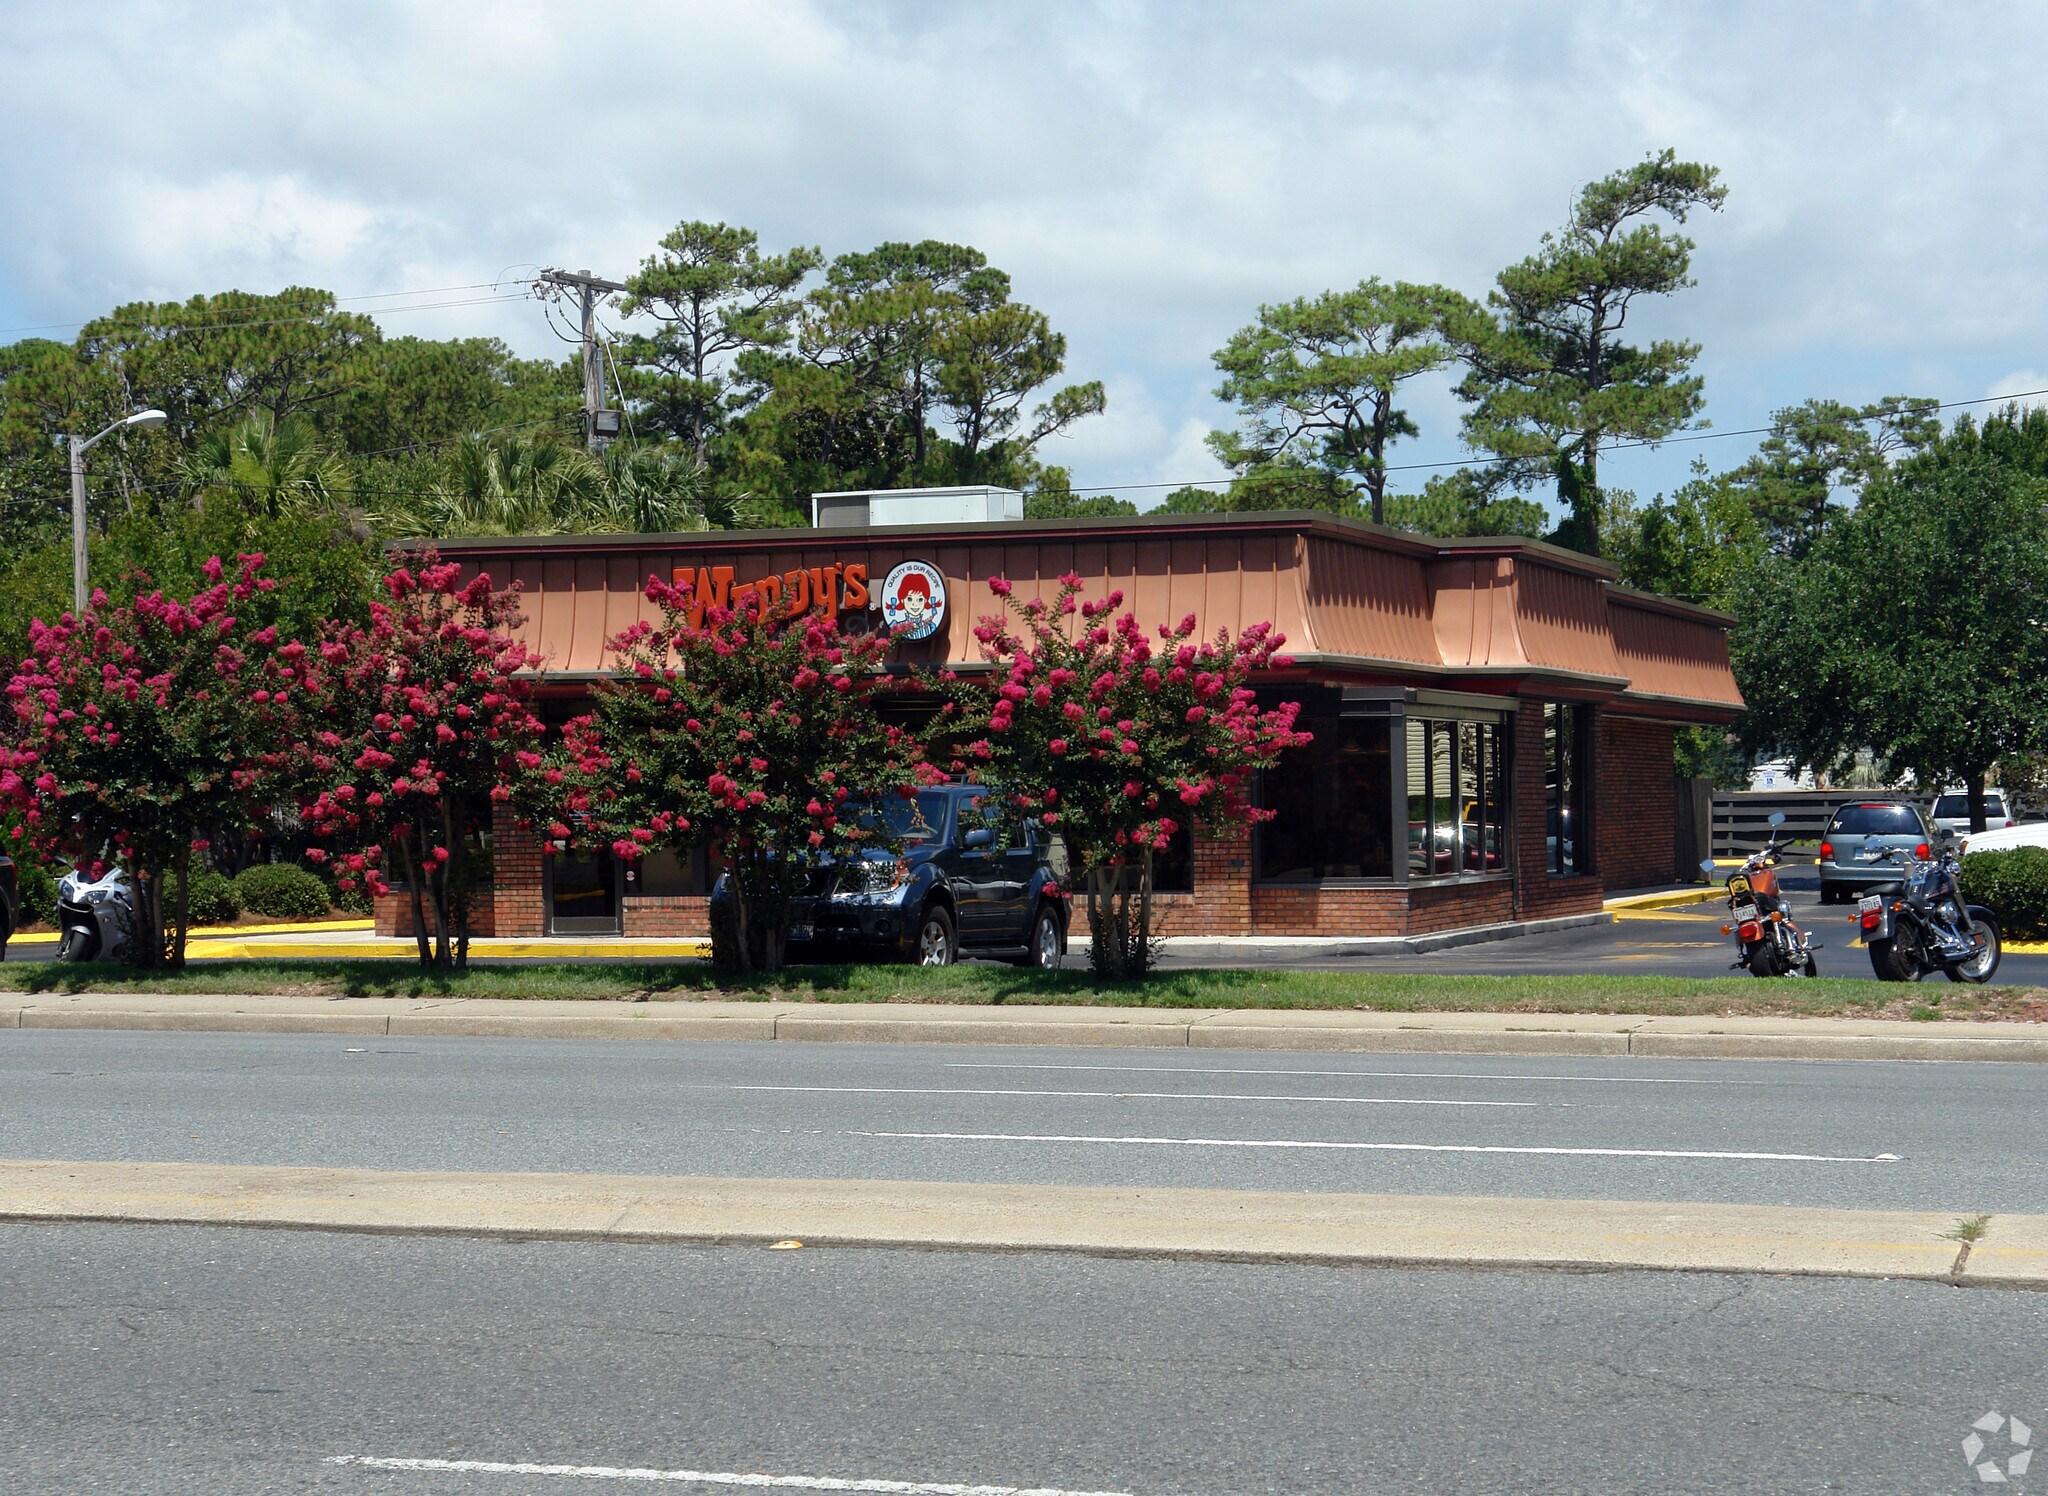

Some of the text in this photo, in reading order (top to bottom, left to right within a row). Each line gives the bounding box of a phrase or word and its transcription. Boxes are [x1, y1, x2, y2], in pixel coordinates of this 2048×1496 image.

[888, 568, 905, 588] QUALITY
[913, 565, 925, 573] OUR
[926, 570, 940, 588] RECIPE
